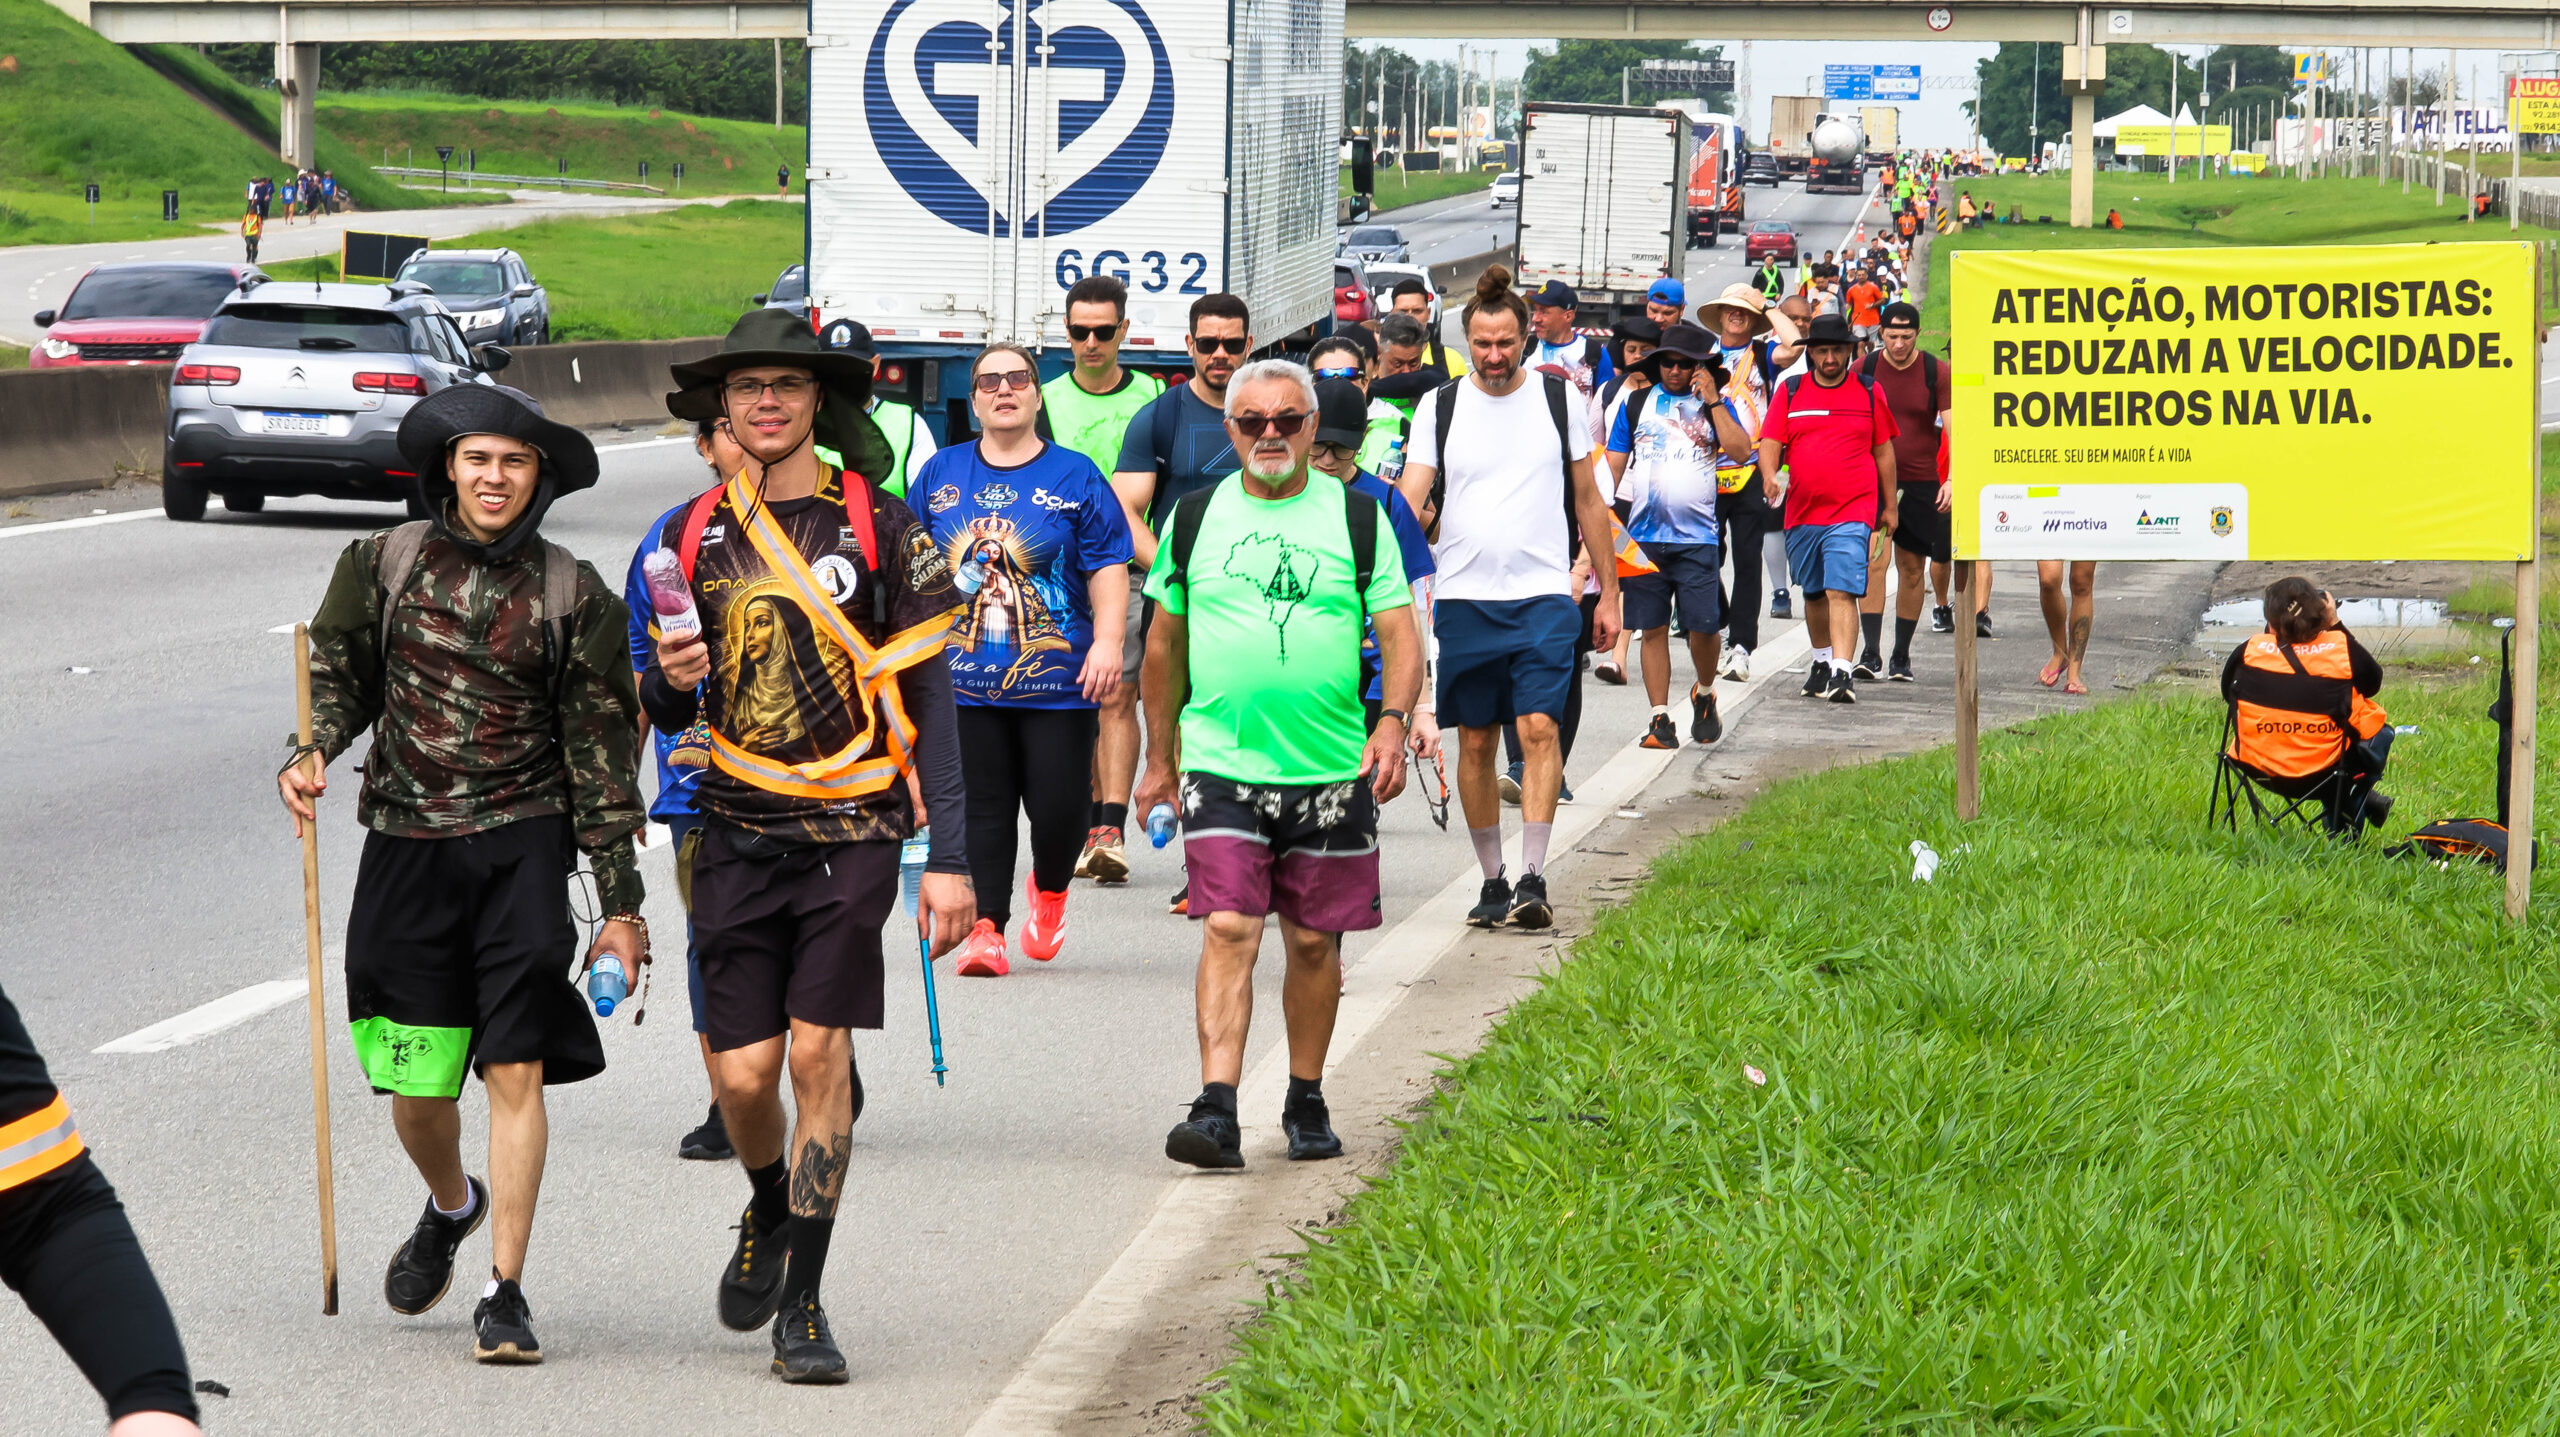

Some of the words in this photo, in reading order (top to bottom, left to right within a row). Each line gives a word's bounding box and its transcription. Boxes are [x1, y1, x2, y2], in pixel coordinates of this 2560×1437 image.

[2512, 80, 2560, 97] ALUG
[1056, 249, 1208, 295] 6G32
[1992, 278, 2194, 332] ATENÇÃO,
[2206, 279, 2492, 321] MOTORISTAS:
[1994, 339, 2190, 375] REDUZAM
[2202, 338, 2229, 373] A
[2238, 333, 2512, 372] VELOCIDADE.
[1994, 390, 2212, 427] ROMEIROS
[2223, 390, 2279, 425] NA
[2289, 389, 2371, 424] VIA.
[1994, 449, 2061, 463] DESACELERE.
[2065, 449, 2084, 463] SEU
[2087, 449, 2109, 462] BEM
[2112, 449, 2145, 462] MAIOR
[2149, 446, 2155, 462] É
[2158, 449, 2165, 462] A
[2168, 448, 2192, 462] VIDA
[2063, 518, 2107, 530] motiva
[2153, 517, 2180, 526] ANTT
[703, 578, 748, 592] DNA
[984, 664, 1003, 673] a
[1002, 646, 1068, 690] fé
[967, 679, 997, 688] GUIE
[1017, 682, 1063, 691] SEMPRE
[2256, 722, 2340, 734] FOTOP.COM
